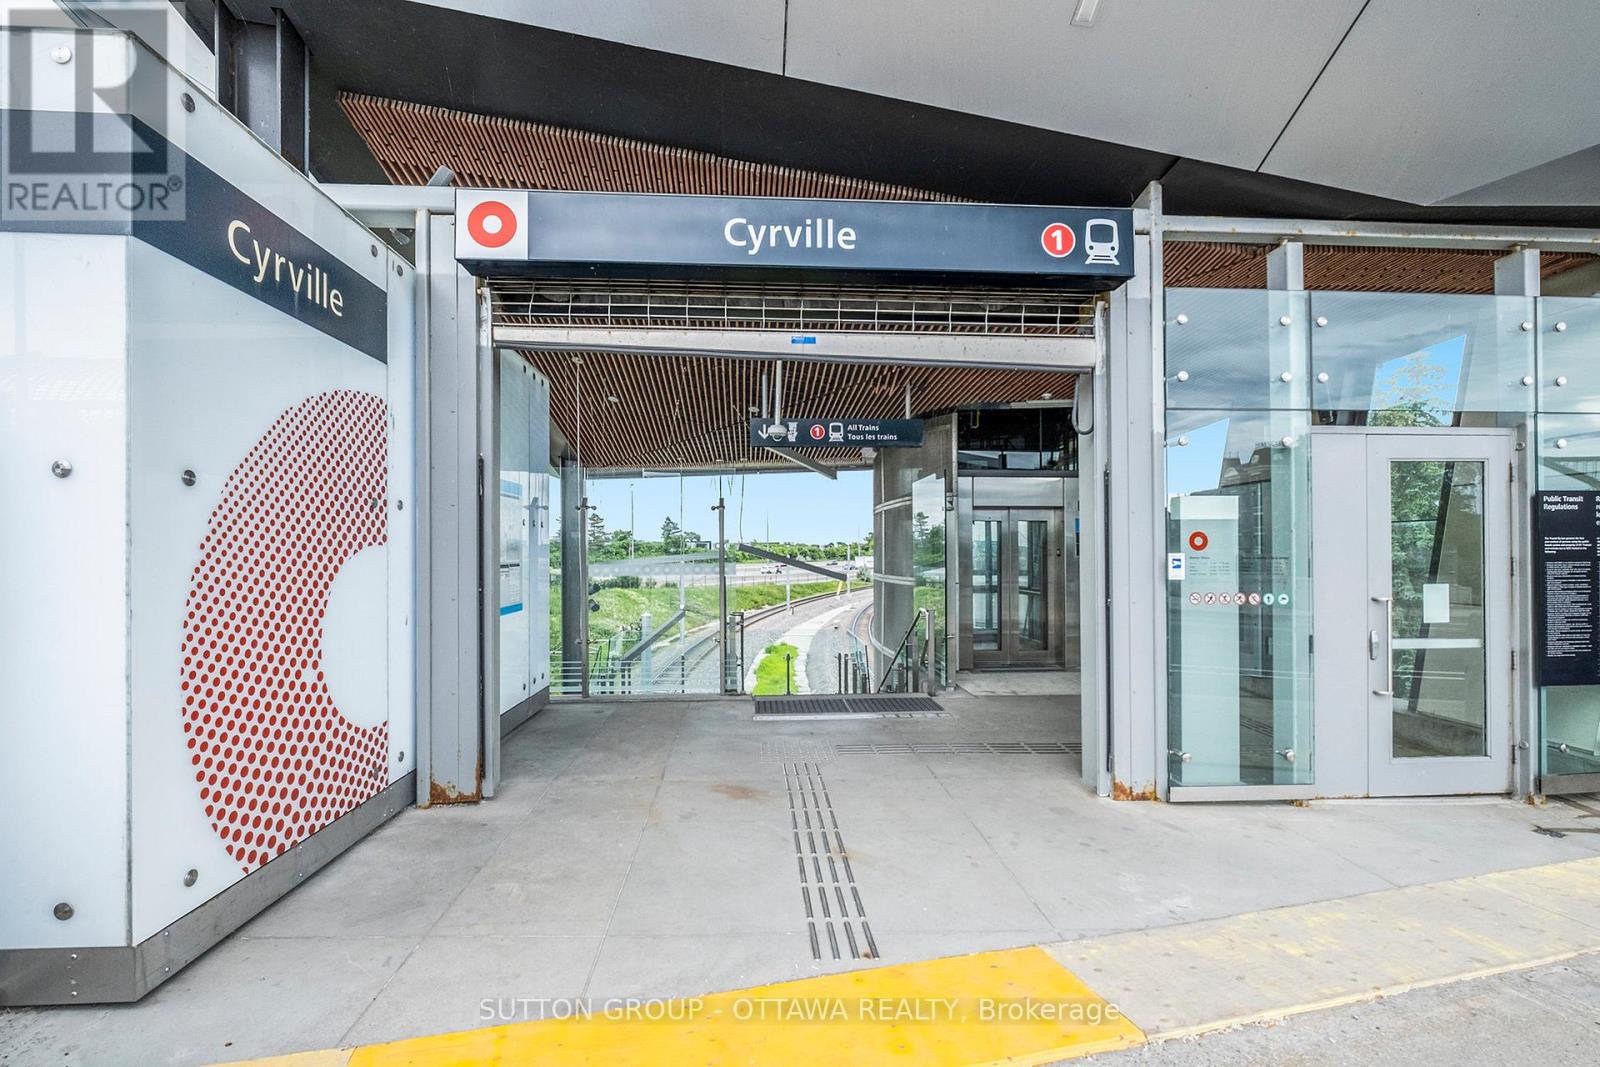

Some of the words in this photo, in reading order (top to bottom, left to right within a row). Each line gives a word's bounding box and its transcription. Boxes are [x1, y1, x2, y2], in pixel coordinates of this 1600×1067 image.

[723, 217, 857, 255] Cyrville
[1050, 229, 1063, 251] 1
[227, 219, 344, 317] Cyrville
[1543, 503, 1579, 512] Regulations
